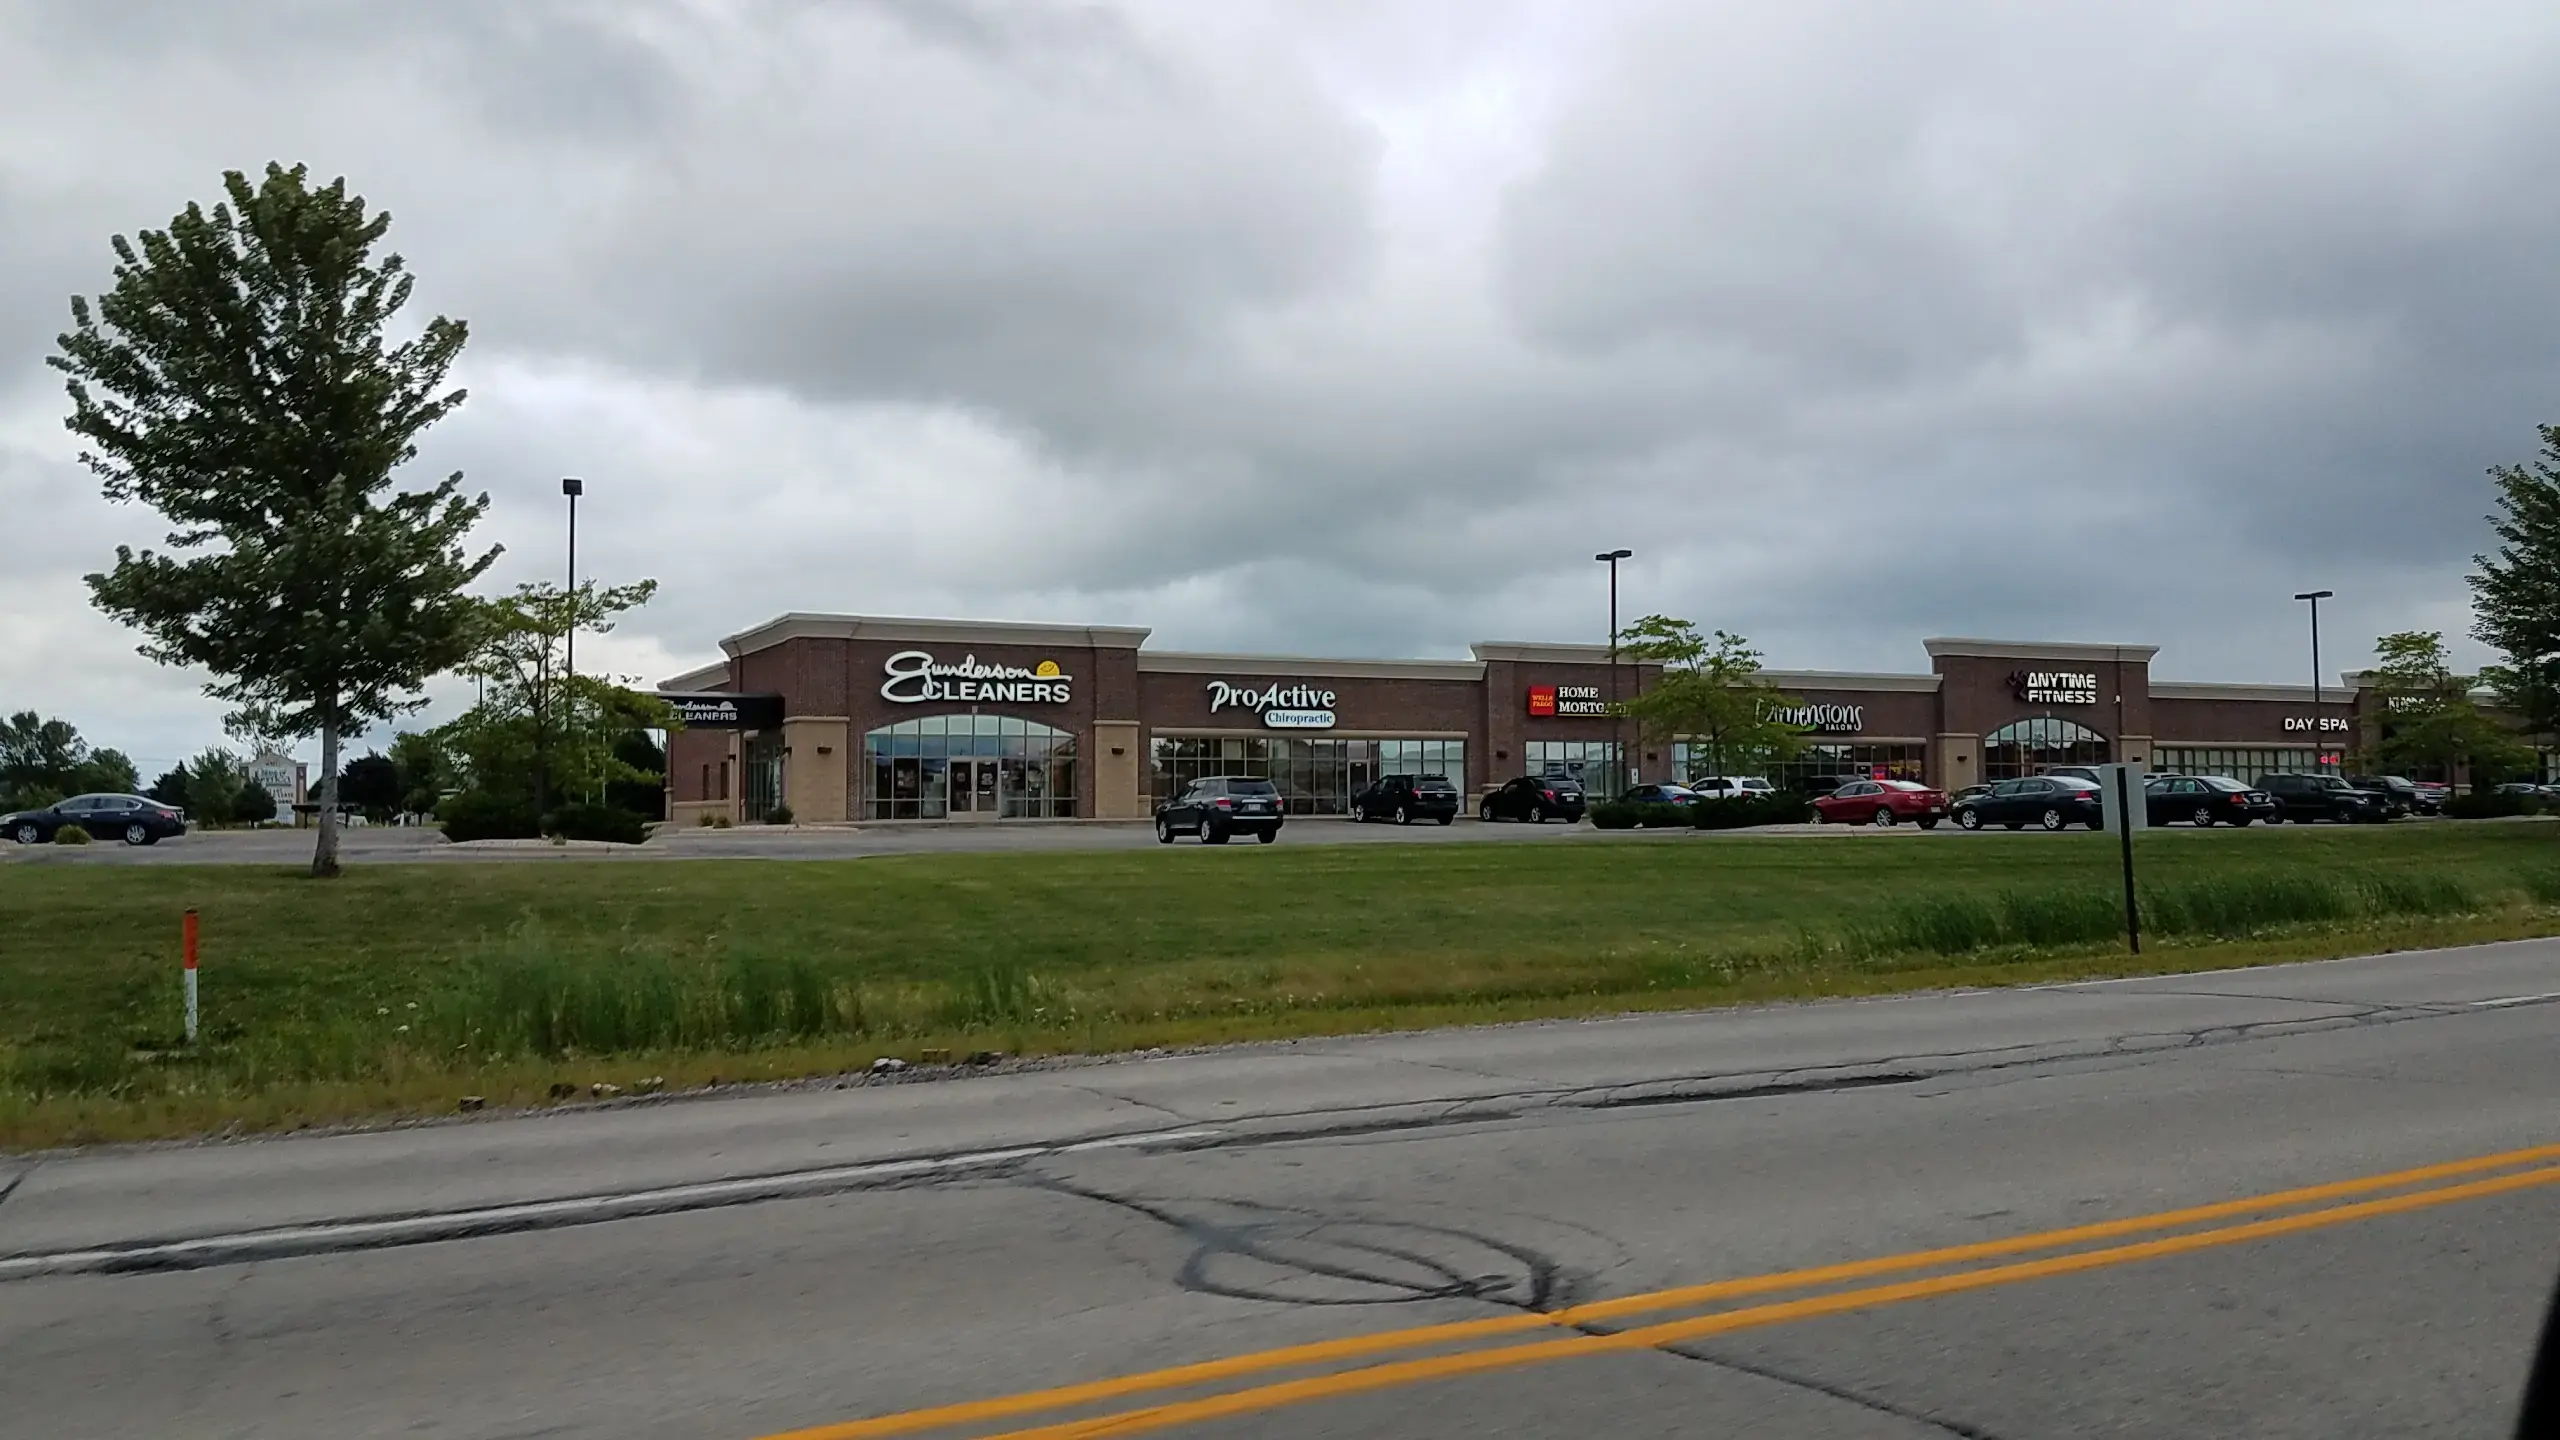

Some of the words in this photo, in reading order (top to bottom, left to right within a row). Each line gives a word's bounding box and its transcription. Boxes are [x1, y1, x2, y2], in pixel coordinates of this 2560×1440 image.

[880, 650, 1072, 702] Gunderson
[2027, 672, 2096, 689] ANYTIME
[922, 681, 1071, 703] CLEANERS
[1206, 680, 1336, 713] ProActive
[1558, 686, 1598, 698] HOME
[2028, 689, 2096, 703] FITNESS
[1558, 701, 1628, 714] MORTG
[1268, 712, 1333, 725] Chiropractic
[2284, 718, 2315, 731] DAY
[2319, 718, 2349, 731] SPA
[1825, 723, 1853, 731] SALON
